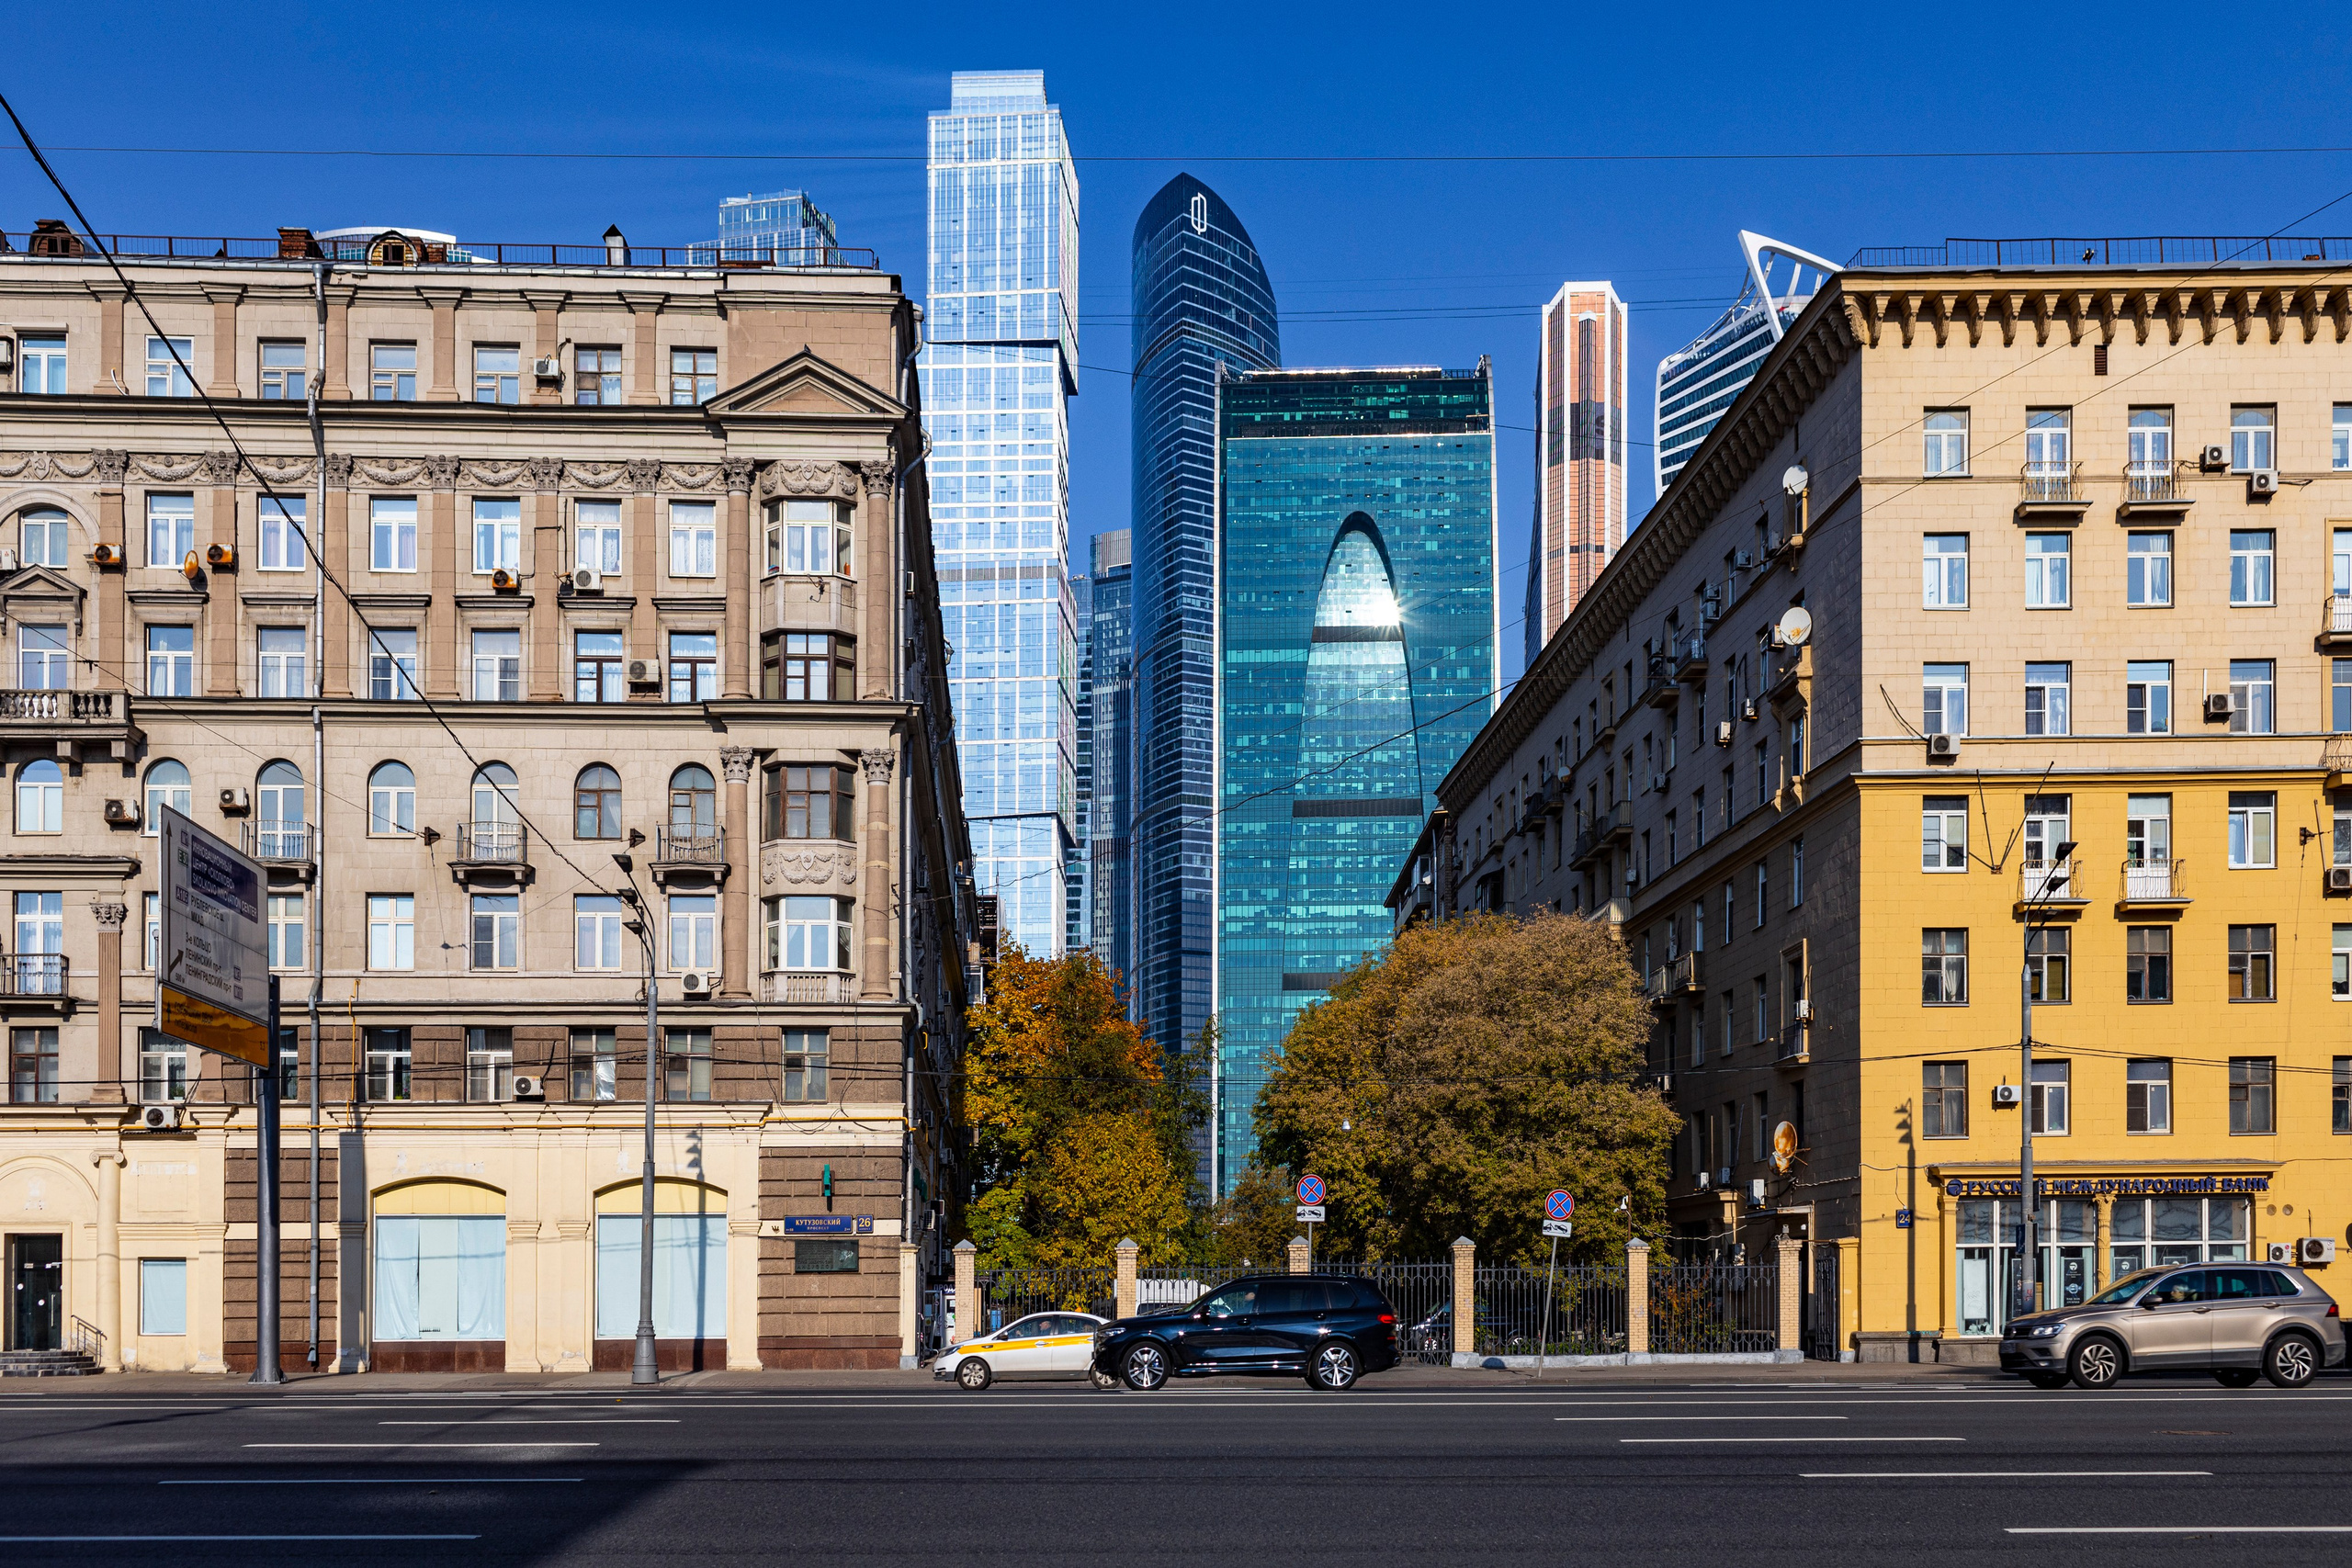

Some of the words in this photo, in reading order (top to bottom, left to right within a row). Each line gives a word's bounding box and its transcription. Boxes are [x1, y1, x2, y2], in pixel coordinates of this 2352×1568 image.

[192, 840, 232, 874] ИННОВАЦИОННЫЙ
[192, 856, 208, 874] ЦЕНТР
[192, 873, 217, 895] SKOLKOVO
[217, 886, 241, 908] INNOVATION
[241, 900, 257, 917] CENTER
[191, 895, 220, 919] РУБЛЕВСКОЕ
[191, 911, 204, 927] МКАД
[193, 935, 212, 953] КОЛЬЦО
[186, 948, 213, 969] ЛЕНИНСКИЙ
[186, 964, 223, 989] ЛЕНИНГРАДСКИЙ
[1967, 1178, 2048, 1194] РУССКЙ
[2053, 1176, 2217, 1194] МЕЖДУНАРОДНЫЙ
[2222, 1177, 2270, 1192] БАНК
[795, 1217, 841, 1226] КУТУЗОВСКИЙ
[858, 1217, 871, 1227] 26
[1899, 1213, 1911, 1224] 24
